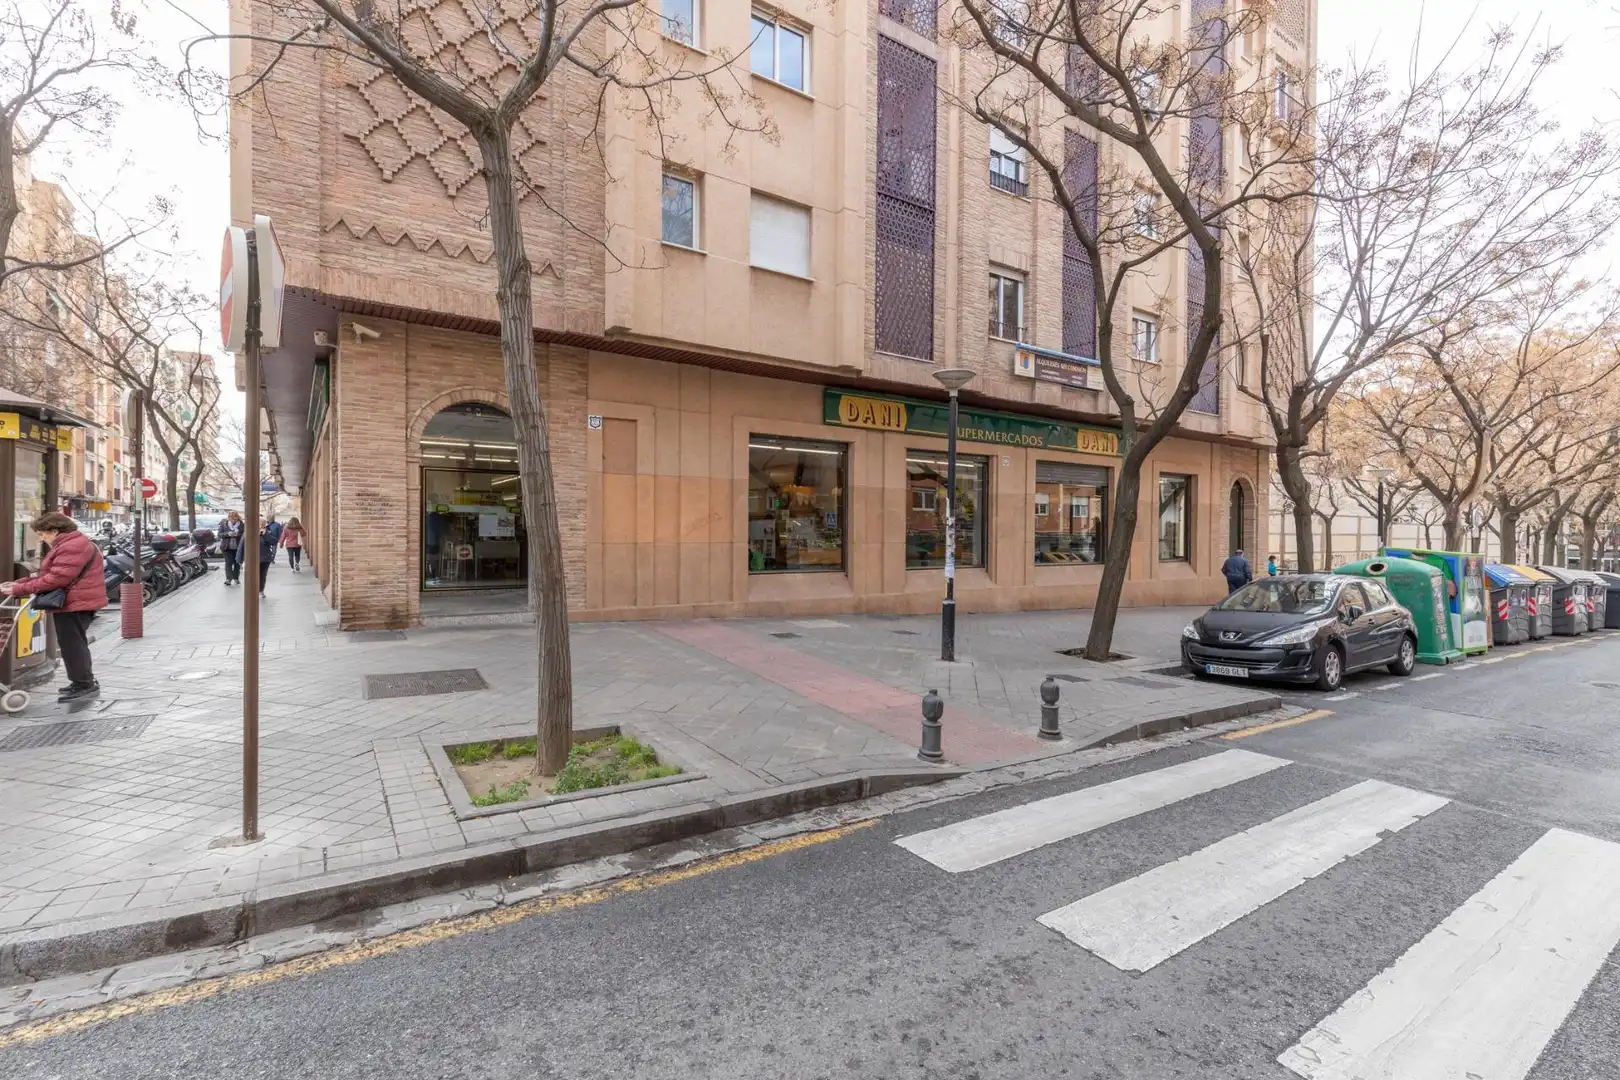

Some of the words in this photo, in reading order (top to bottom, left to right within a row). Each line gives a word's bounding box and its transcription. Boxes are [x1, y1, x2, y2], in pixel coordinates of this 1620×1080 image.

[847, 399, 900, 427] DANI
[956, 427, 1043, 446] UPERMERCADOS
[1081, 430, 1115, 452] DANI
